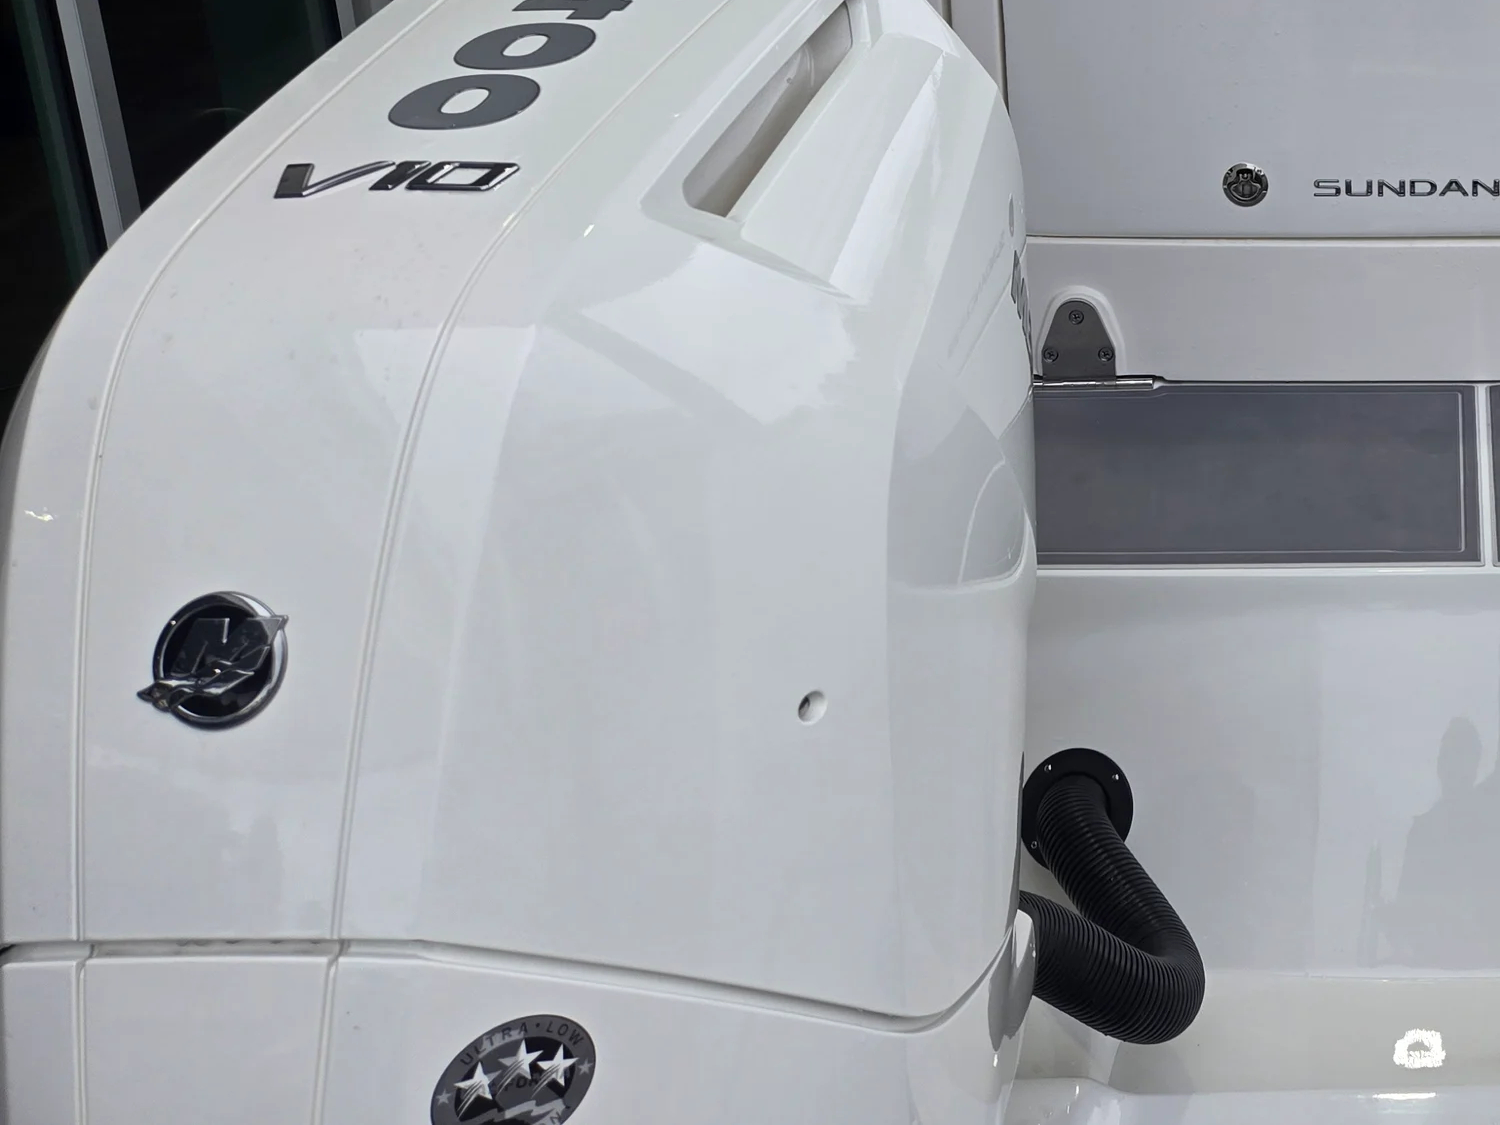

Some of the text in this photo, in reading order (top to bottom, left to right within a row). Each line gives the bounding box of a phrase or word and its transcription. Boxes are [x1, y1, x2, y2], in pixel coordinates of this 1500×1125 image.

[273, 159, 521, 199] V10
[460, 1021, 584, 1065] ULTRA LOW
